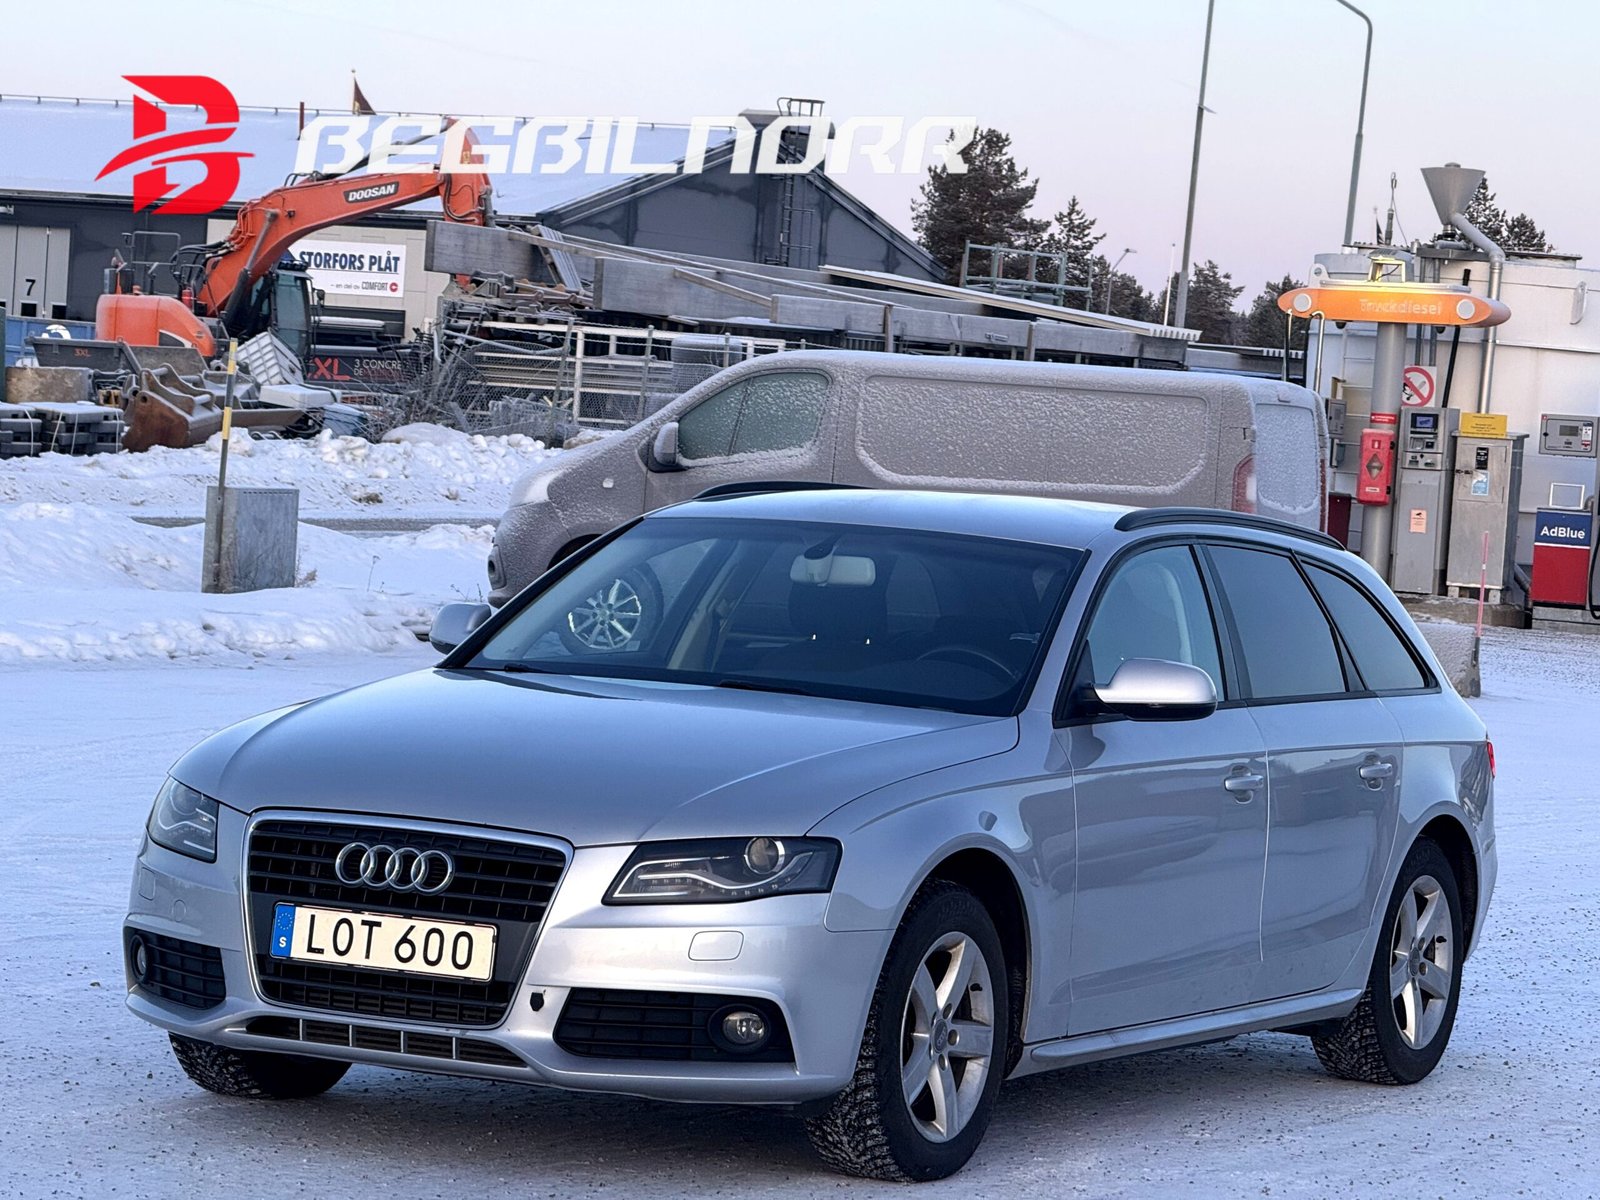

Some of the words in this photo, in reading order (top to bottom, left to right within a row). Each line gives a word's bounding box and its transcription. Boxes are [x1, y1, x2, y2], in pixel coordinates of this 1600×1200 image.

[348, 184, 395, 201] DOOSAN
[299, 251, 364, 271] STORFORS
[368, 250, 400, 273] PLÅT
[25, 279, 36, 296] 7
[361, 281, 388, 292] COMFORT
[74, 348, 90, 358] 3XL
[354, 359, 361, 369] 3
[1540, 525, 1586, 539] AdBlue
[279, 936, 287, 948] S
[306, 913, 382, 960] LOT
[394, 924, 474, 971] 600
